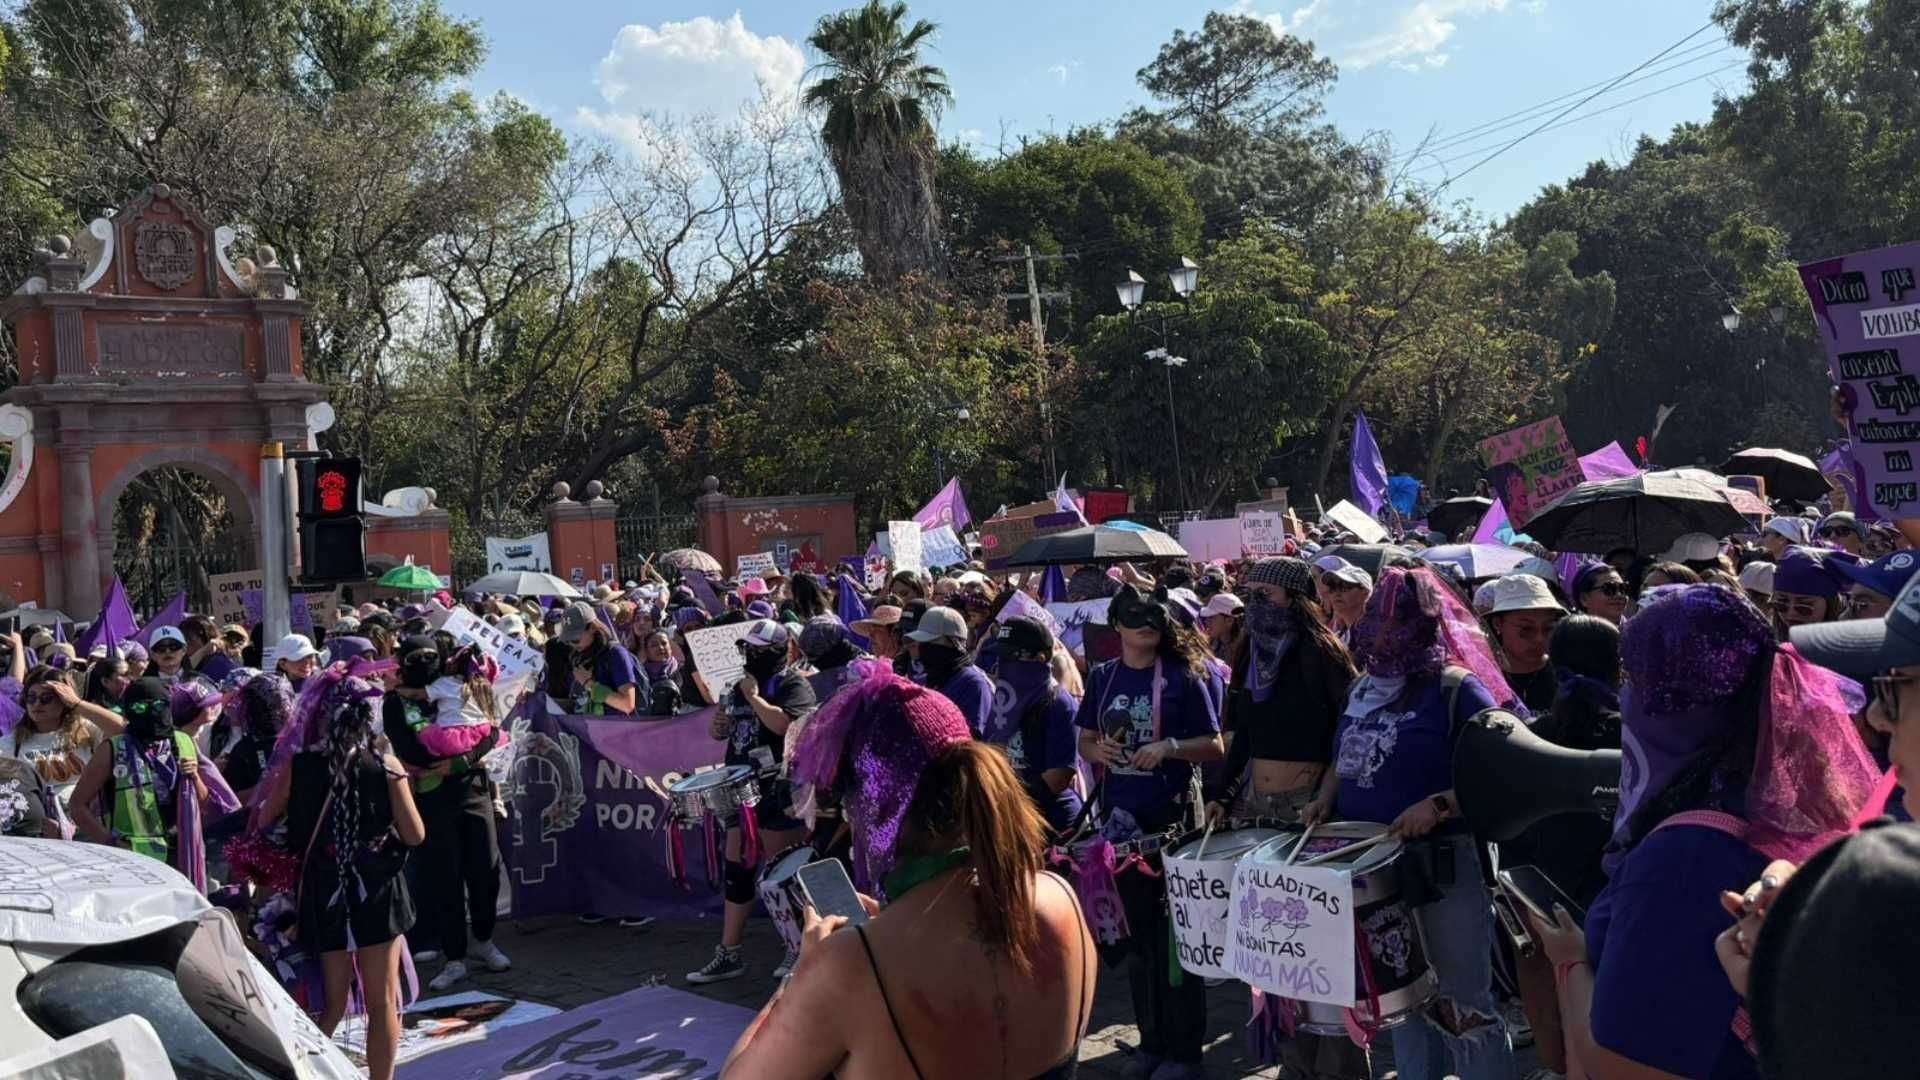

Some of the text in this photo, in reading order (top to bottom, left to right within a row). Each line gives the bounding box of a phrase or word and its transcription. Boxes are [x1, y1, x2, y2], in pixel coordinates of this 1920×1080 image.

[105, 342, 240, 367] HIDALGO
[1871, 380, 1920, 413] Expli
[596, 803, 656, 831] POR
[1175, 903, 1192, 929] al
[1234, 949, 1332, 996] NUNCA MÁS
